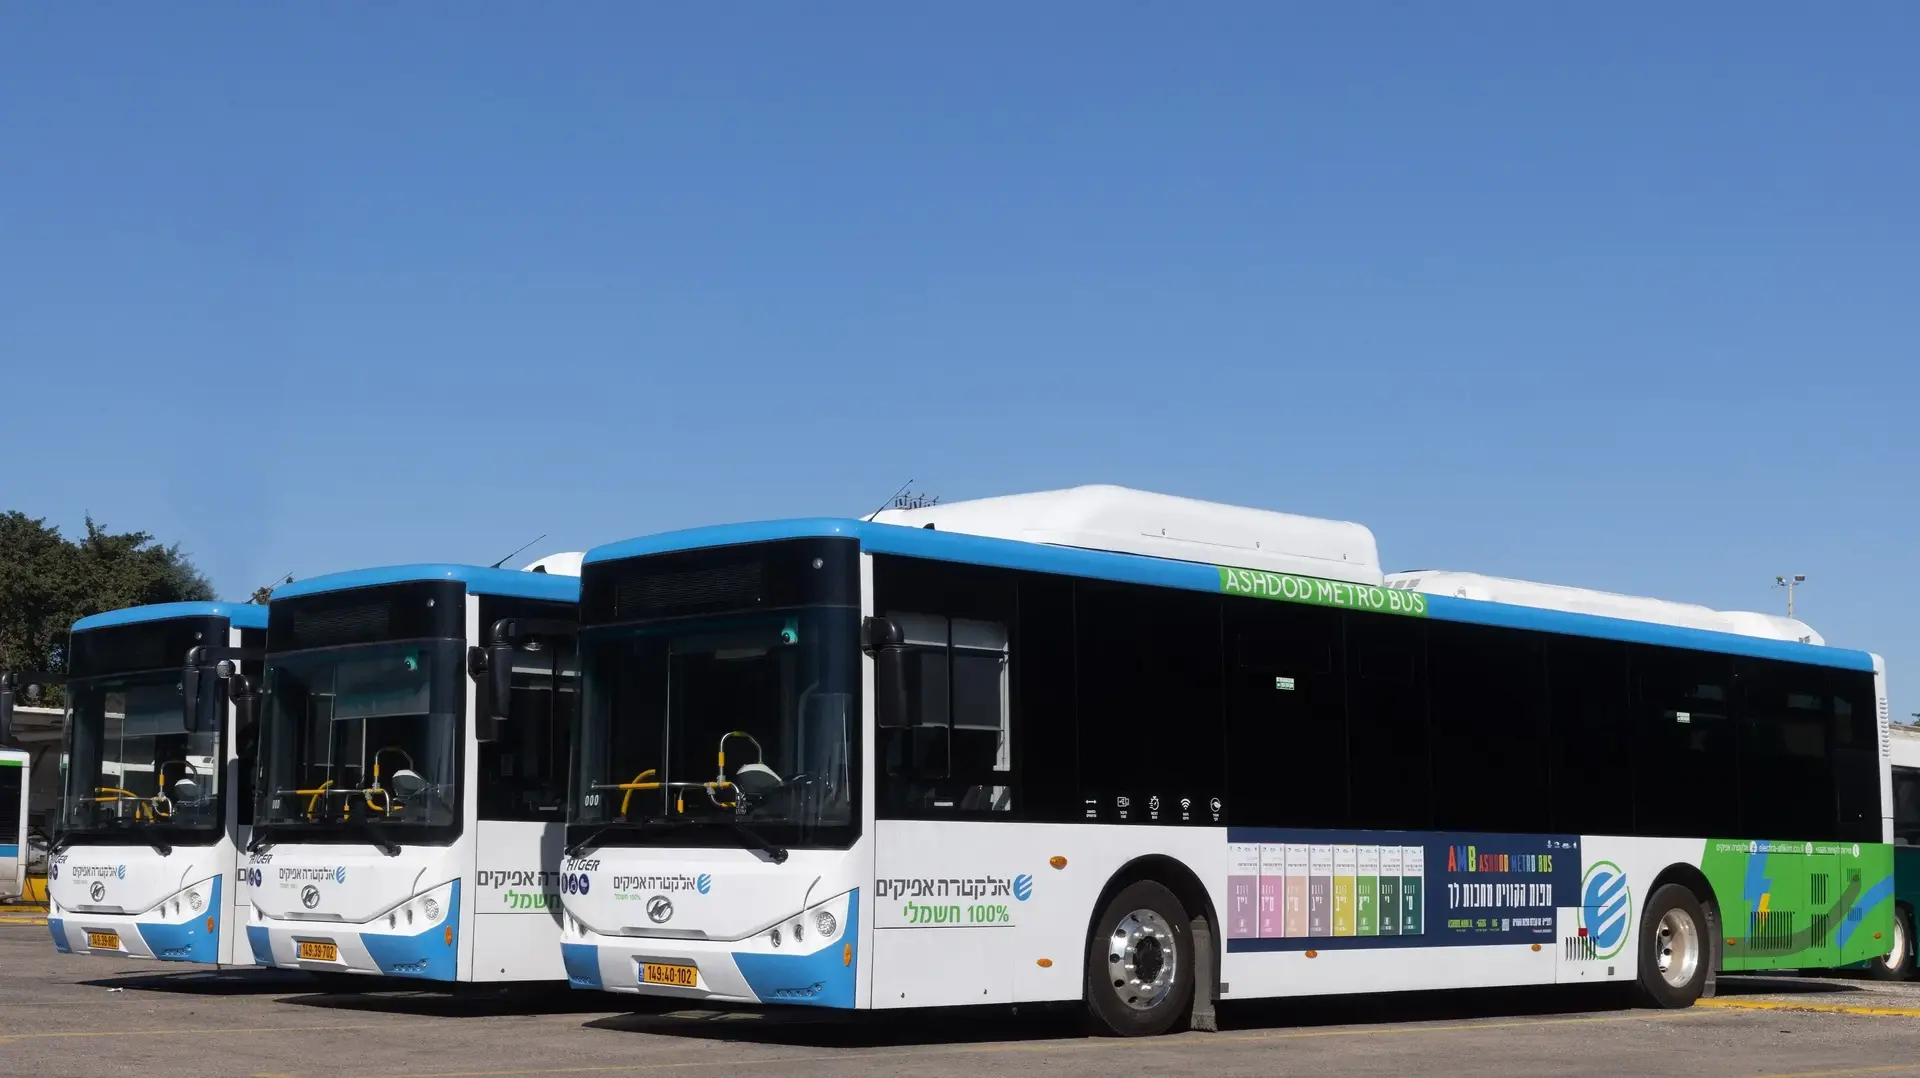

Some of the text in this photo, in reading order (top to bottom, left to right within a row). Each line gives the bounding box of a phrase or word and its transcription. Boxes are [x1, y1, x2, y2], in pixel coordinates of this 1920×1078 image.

[1226, 568, 1424, 613] ASHDOD METRO BUS
[566, 859, 601, 872] HIGER
[1447, 845, 1553, 872] AMB ASHDOD METRO BUS
[279, 867, 335, 882] אלקטרה אפיקים
[477, 870, 535, 889] אפיקים
[613, 874, 696, 892] אלקטרה אפיקים
[503, 889, 560, 908] חשמלי
[875, 875, 1011, 901] אלקטרה אפיקים
[1447, 882, 1552, 909] מפות הקווים מחכות לך
[903, 900, 1010, 924] 100% חשמלי
